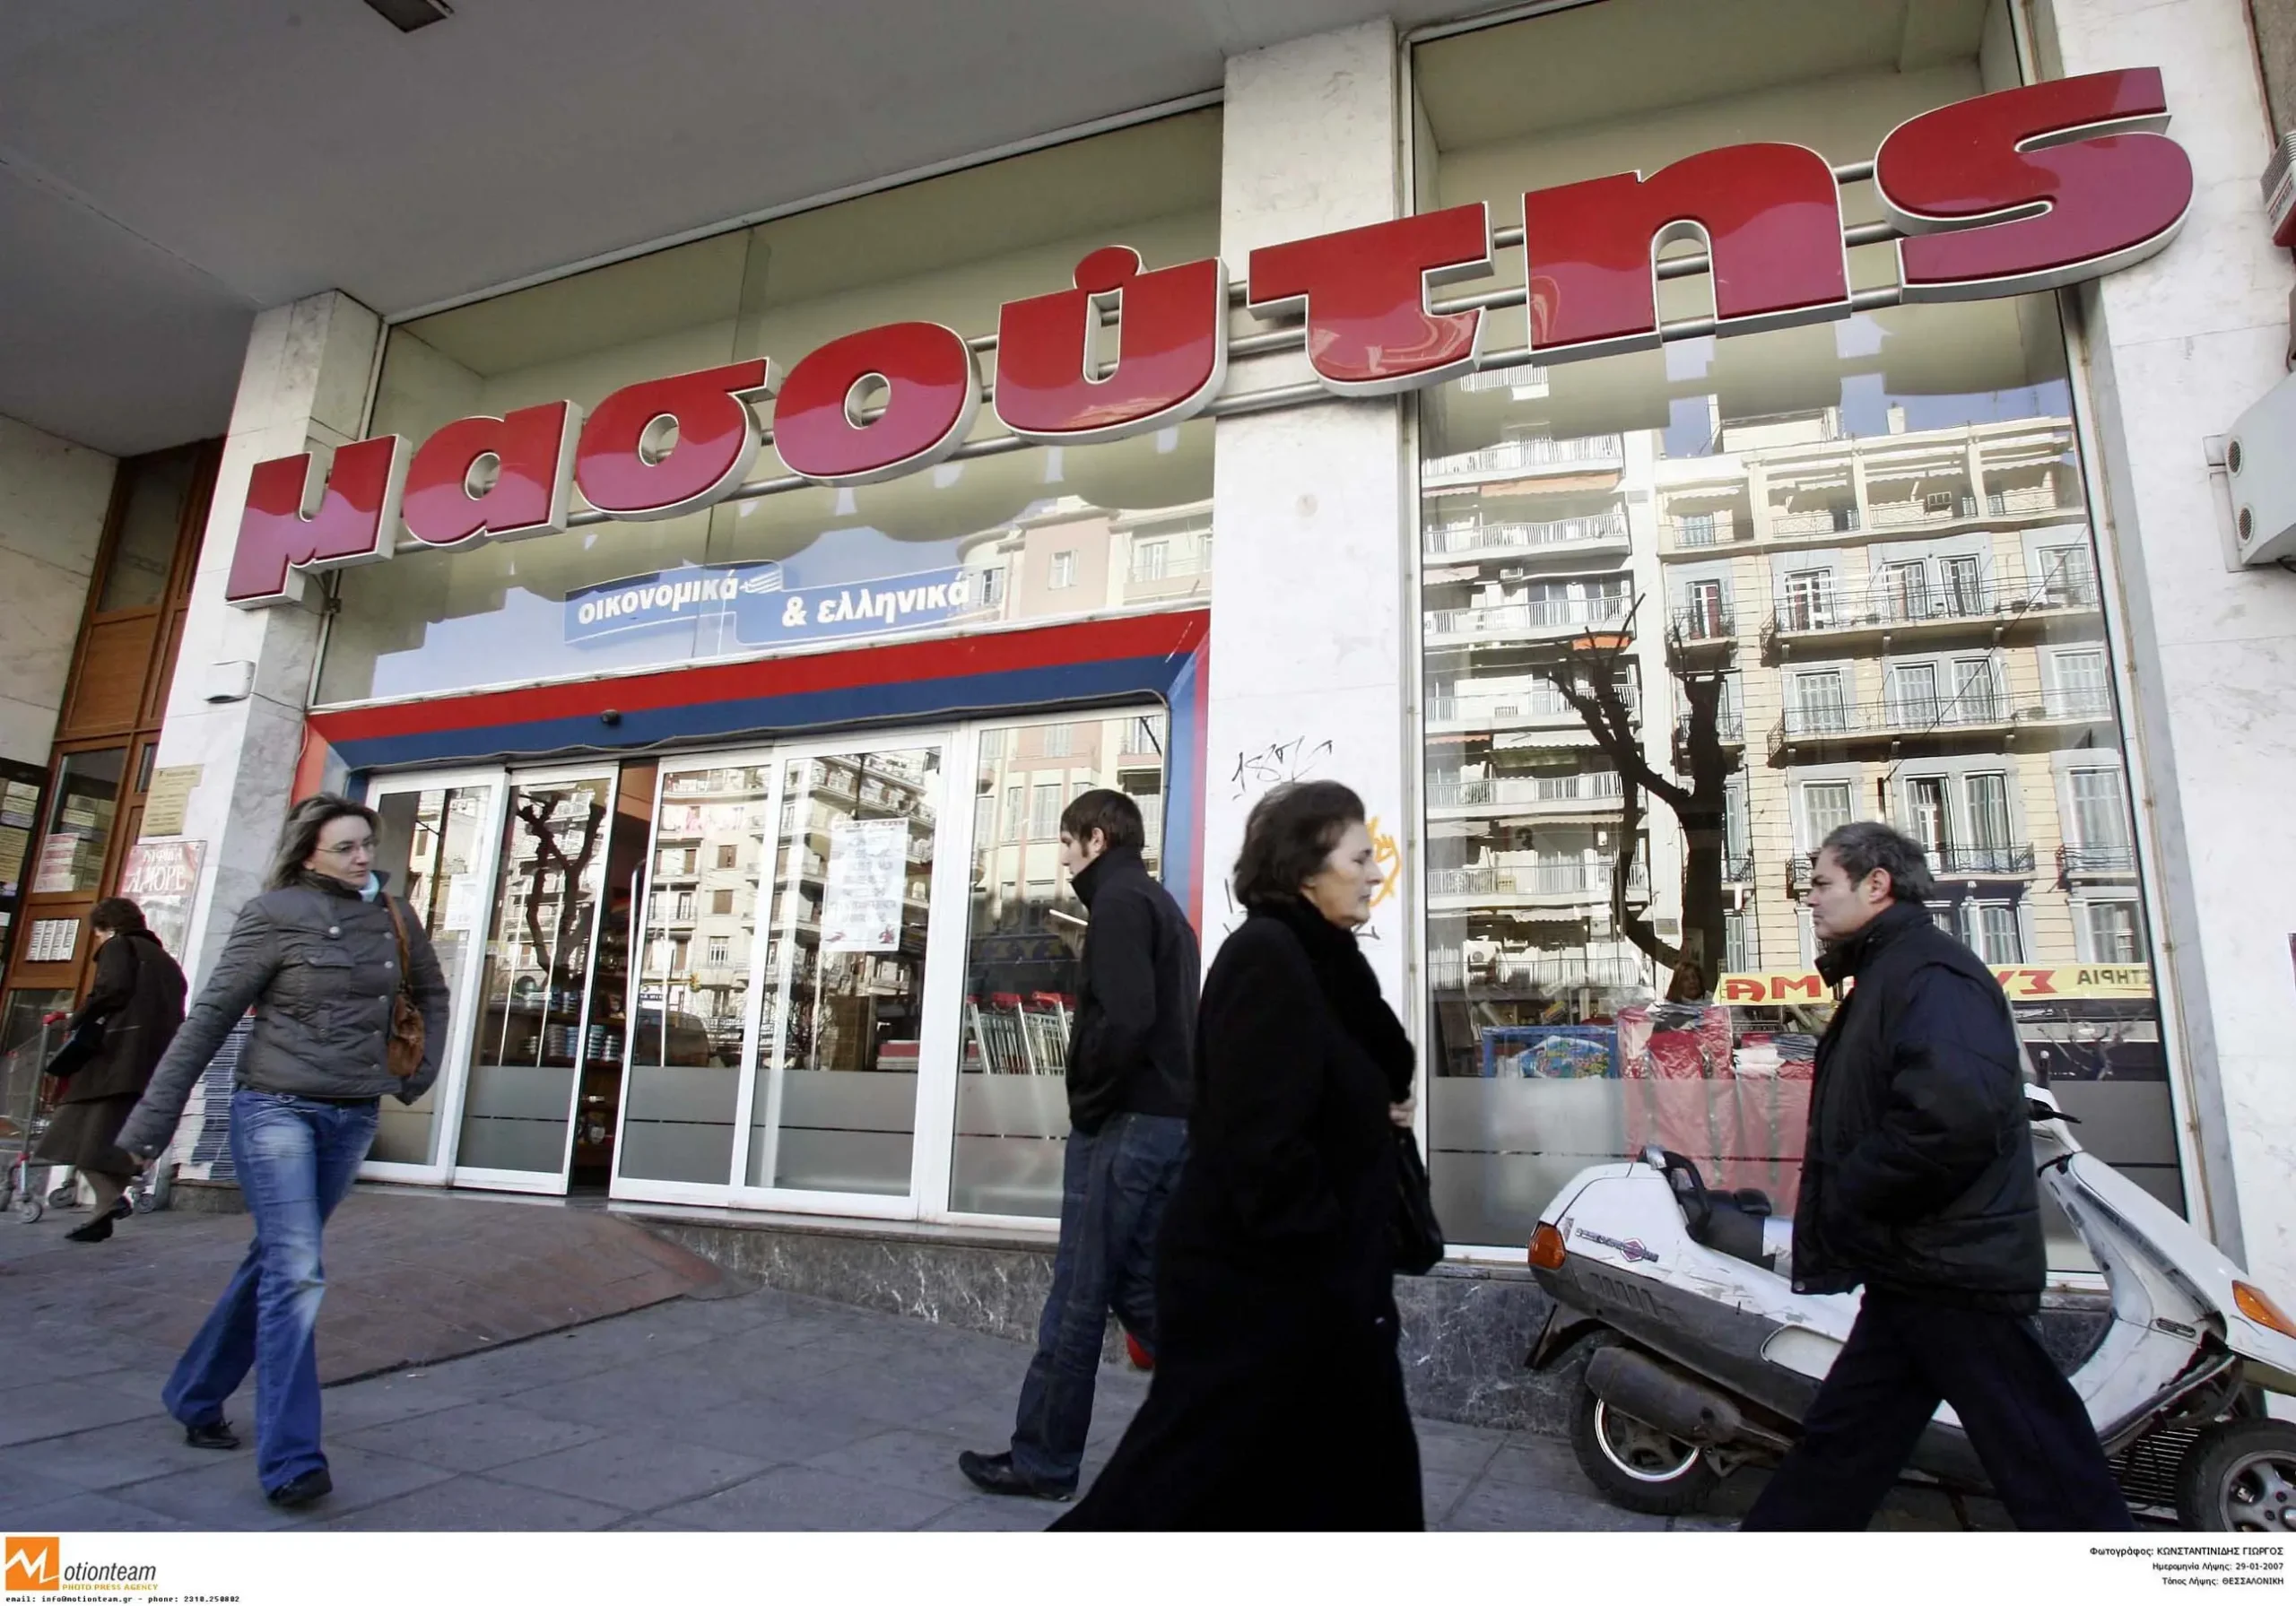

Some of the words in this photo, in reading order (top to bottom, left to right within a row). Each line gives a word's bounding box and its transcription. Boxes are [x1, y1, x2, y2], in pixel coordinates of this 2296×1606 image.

[578, 569, 740, 625] οικονομικά
[782, 596, 806, 626] &
[816, 571, 971, 625] ελληνικά
